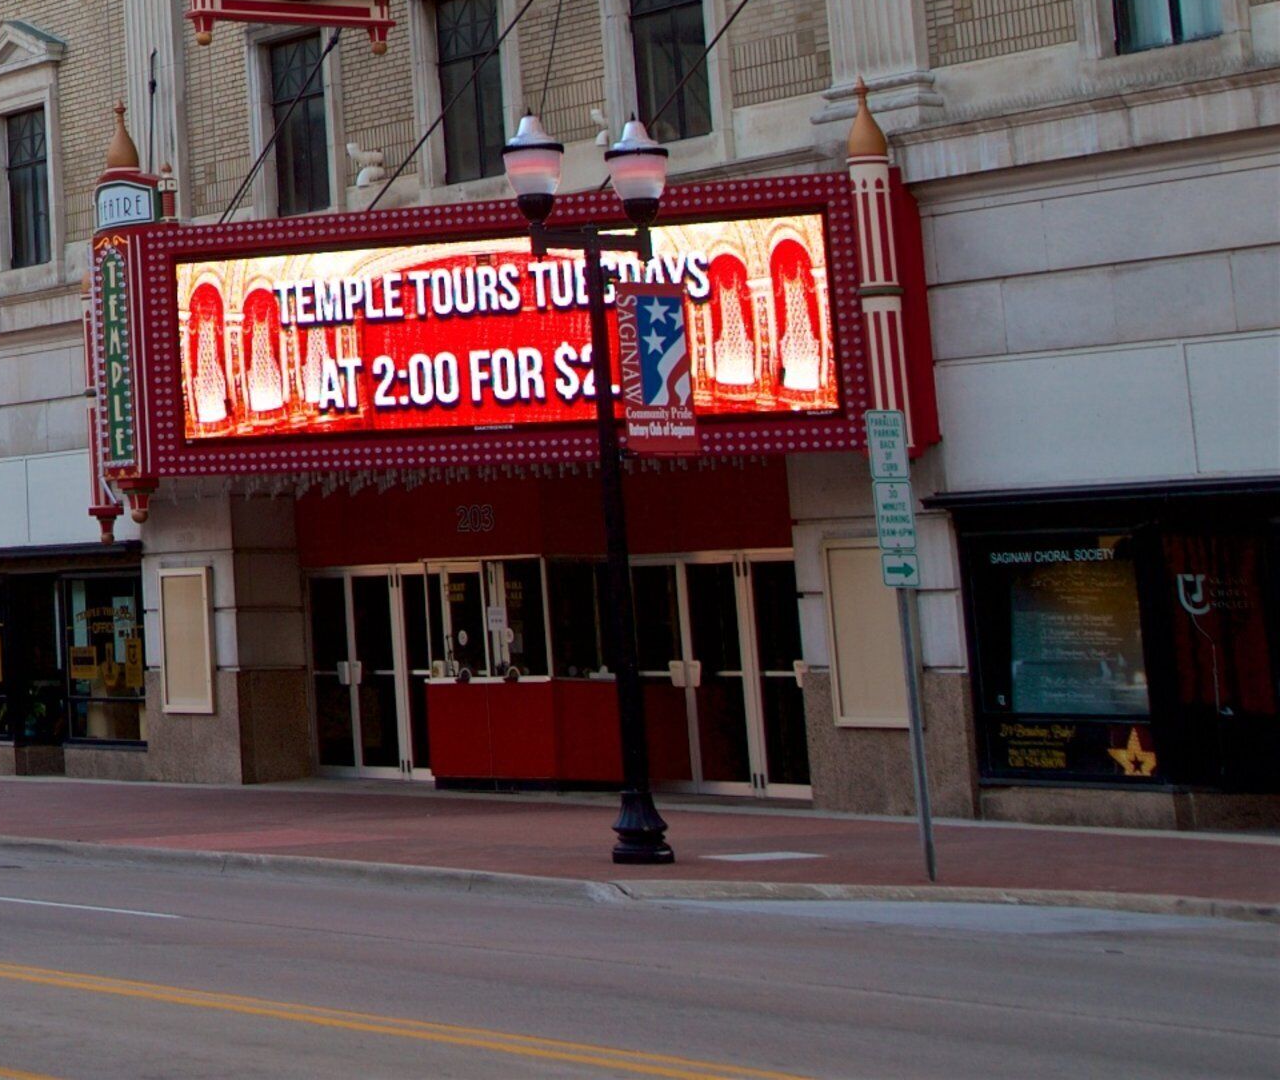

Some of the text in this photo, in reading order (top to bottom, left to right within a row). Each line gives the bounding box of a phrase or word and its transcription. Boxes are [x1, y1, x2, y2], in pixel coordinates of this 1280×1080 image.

[100, 195, 142, 221] EATRE
[273, 272, 404, 326] TEMPLE
[408, 263, 521, 317] TOURS
[107, 262, 124, 455] TEMPLE
[616, 294, 644, 406] SAGINAW
[319, 341, 621, 410] AT 2:00 FOR $2.
[626, 406, 693, 421] Community Pride
[873, 428, 900, 438] PARKING
[456, 504, 495, 532] 203
[881, 515, 910, 524] PARKING
[882, 503, 906, 511] MINUTE
[990, 548, 1115, 564] SAGINAW CHORAL SOCIETY
